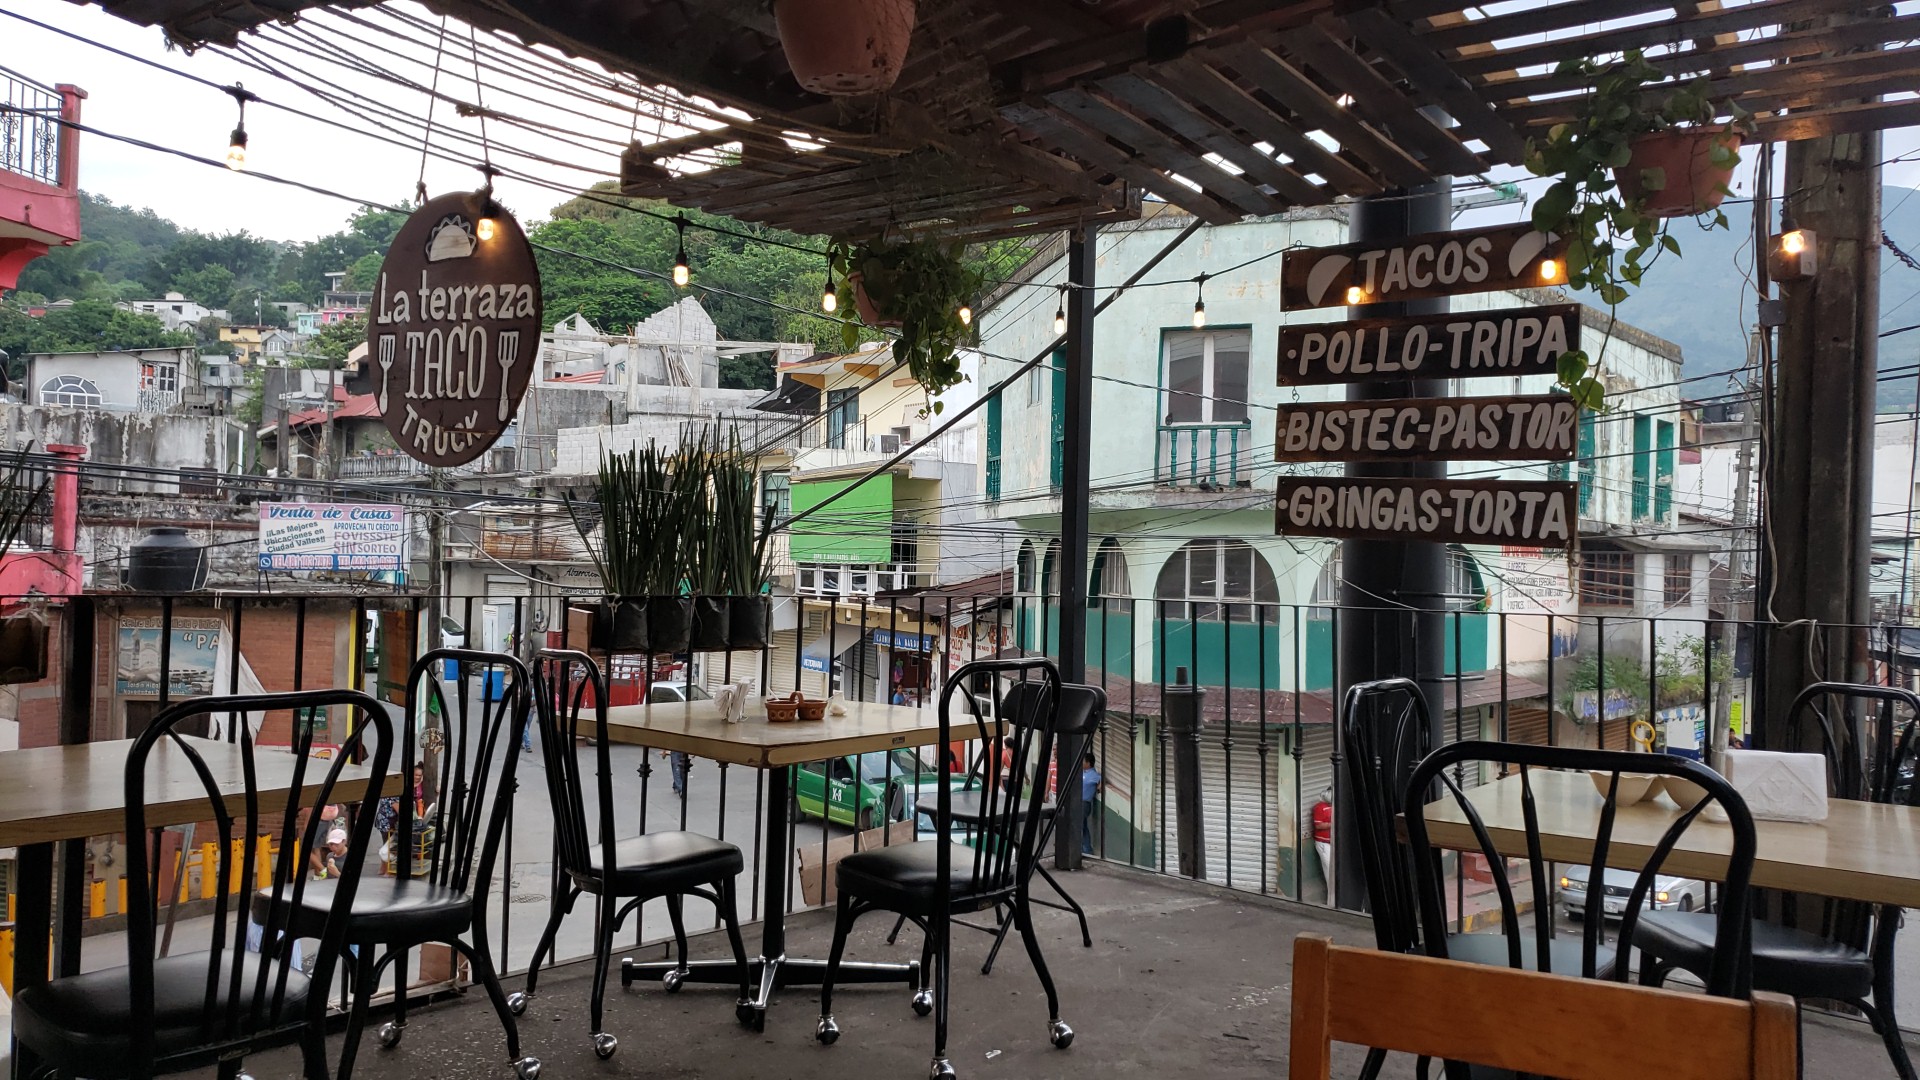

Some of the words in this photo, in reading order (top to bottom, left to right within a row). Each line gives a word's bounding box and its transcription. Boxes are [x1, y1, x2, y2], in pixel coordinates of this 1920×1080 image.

[1359, 236, 1492, 294] TACOS
[377, 271, 411, 324] La
[419, 269, 535, 321] terraza
[404, 323, 488, 400] TACO
[401, 403, 482, 457] TRUCK
[269, 505, 315, 519] Venta
[322, 506, 343, 519] de
[350, 506, 394, 520] Casas
[287, 521, 318, 533] Mejores
[334, 522, 367, 530] APROVECHA
[264, 531, 309, 547] Ubicaciones
[314, 528, 324, 536] en
[334, 532, 397, 541] FOVISSSTE
[267, 542, 295, 553] Ciudad
[334, 542, 357, 554] SIN
[358, 544, 397, 553] SORTEO
[832, 787, 842, 802] X-8
